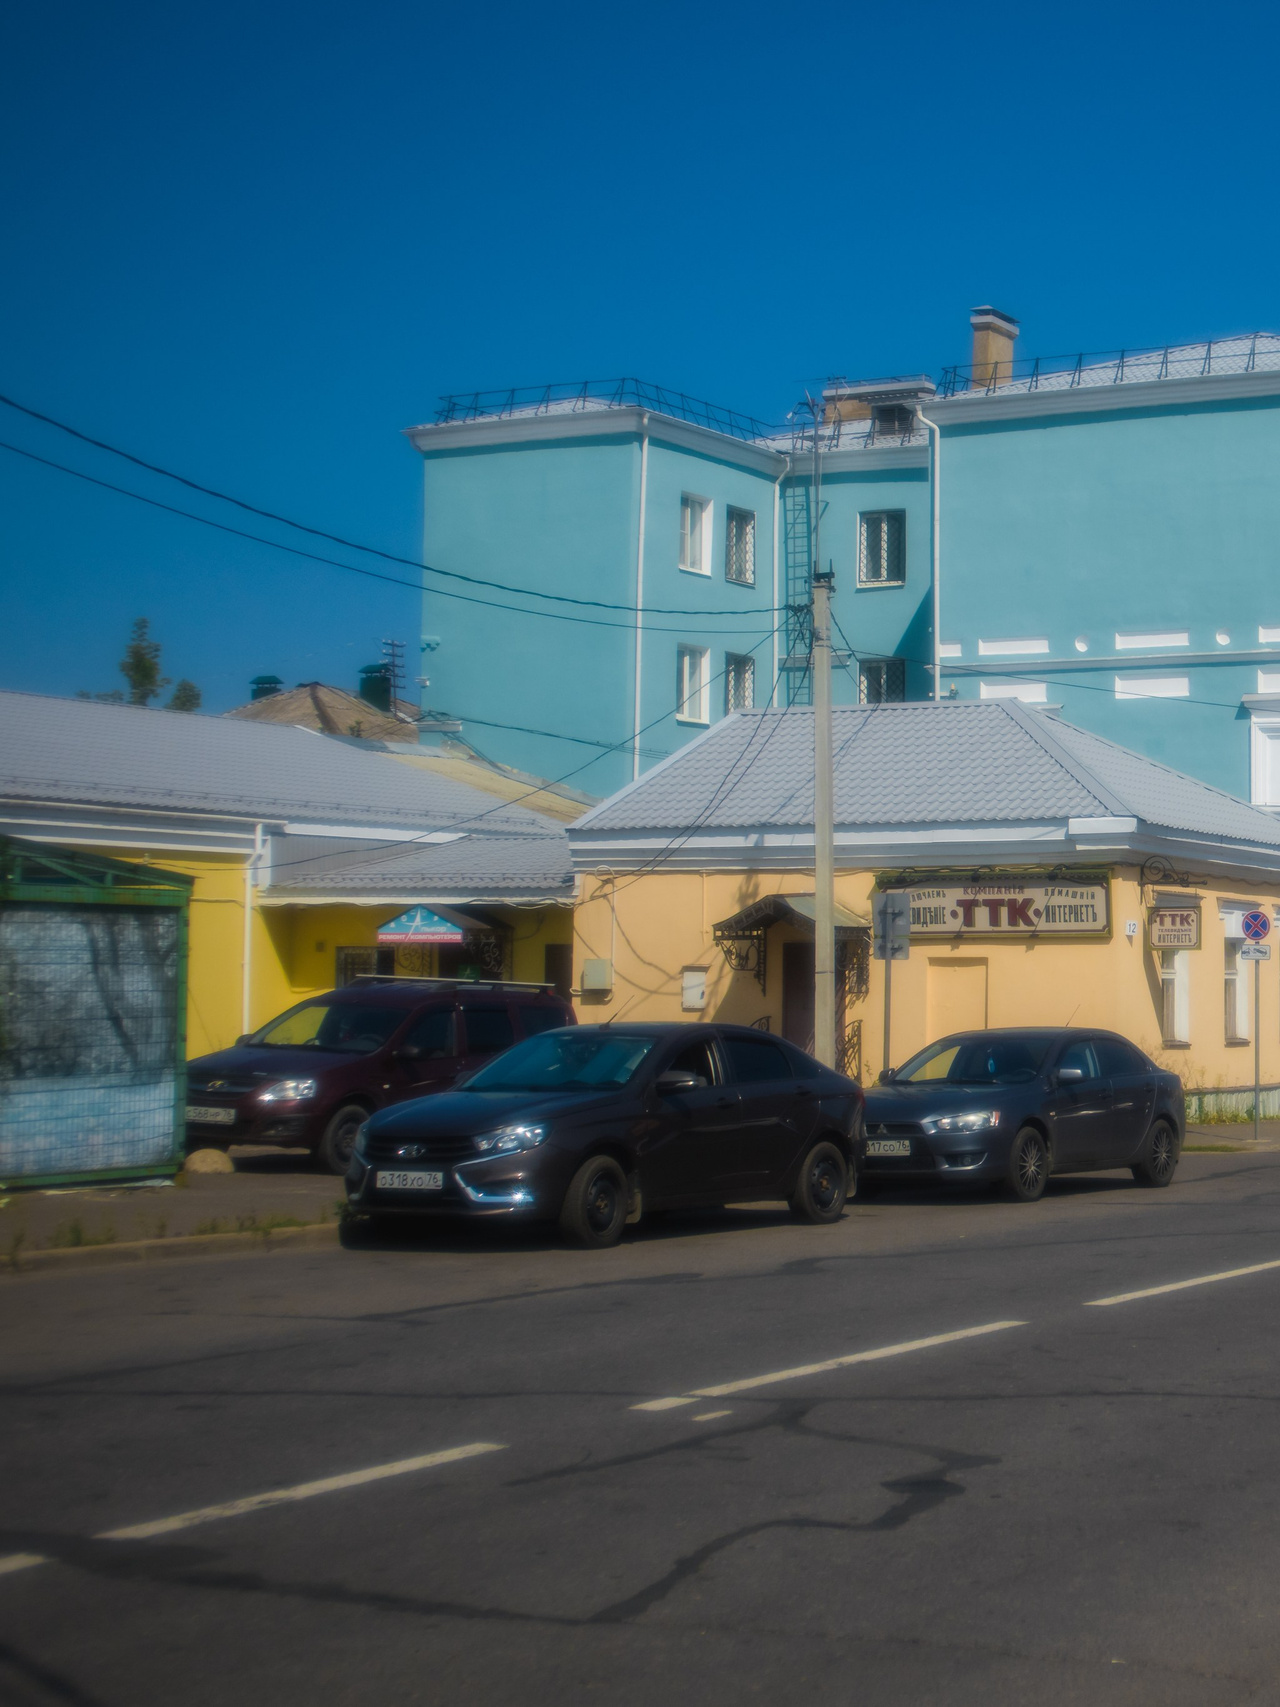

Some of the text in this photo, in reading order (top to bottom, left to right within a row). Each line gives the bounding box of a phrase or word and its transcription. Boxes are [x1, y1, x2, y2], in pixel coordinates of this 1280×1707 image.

[910, 890, 946, 902] ЛЮЧАЕМЪ
[956, 898, 1036, 927] ТТК
[1044, 904, 1098, 923] ИНТЕРНЕТЪ
[1157, 913, 1192, 927] ТТК
[1128, 923, 1137, 933] 12
